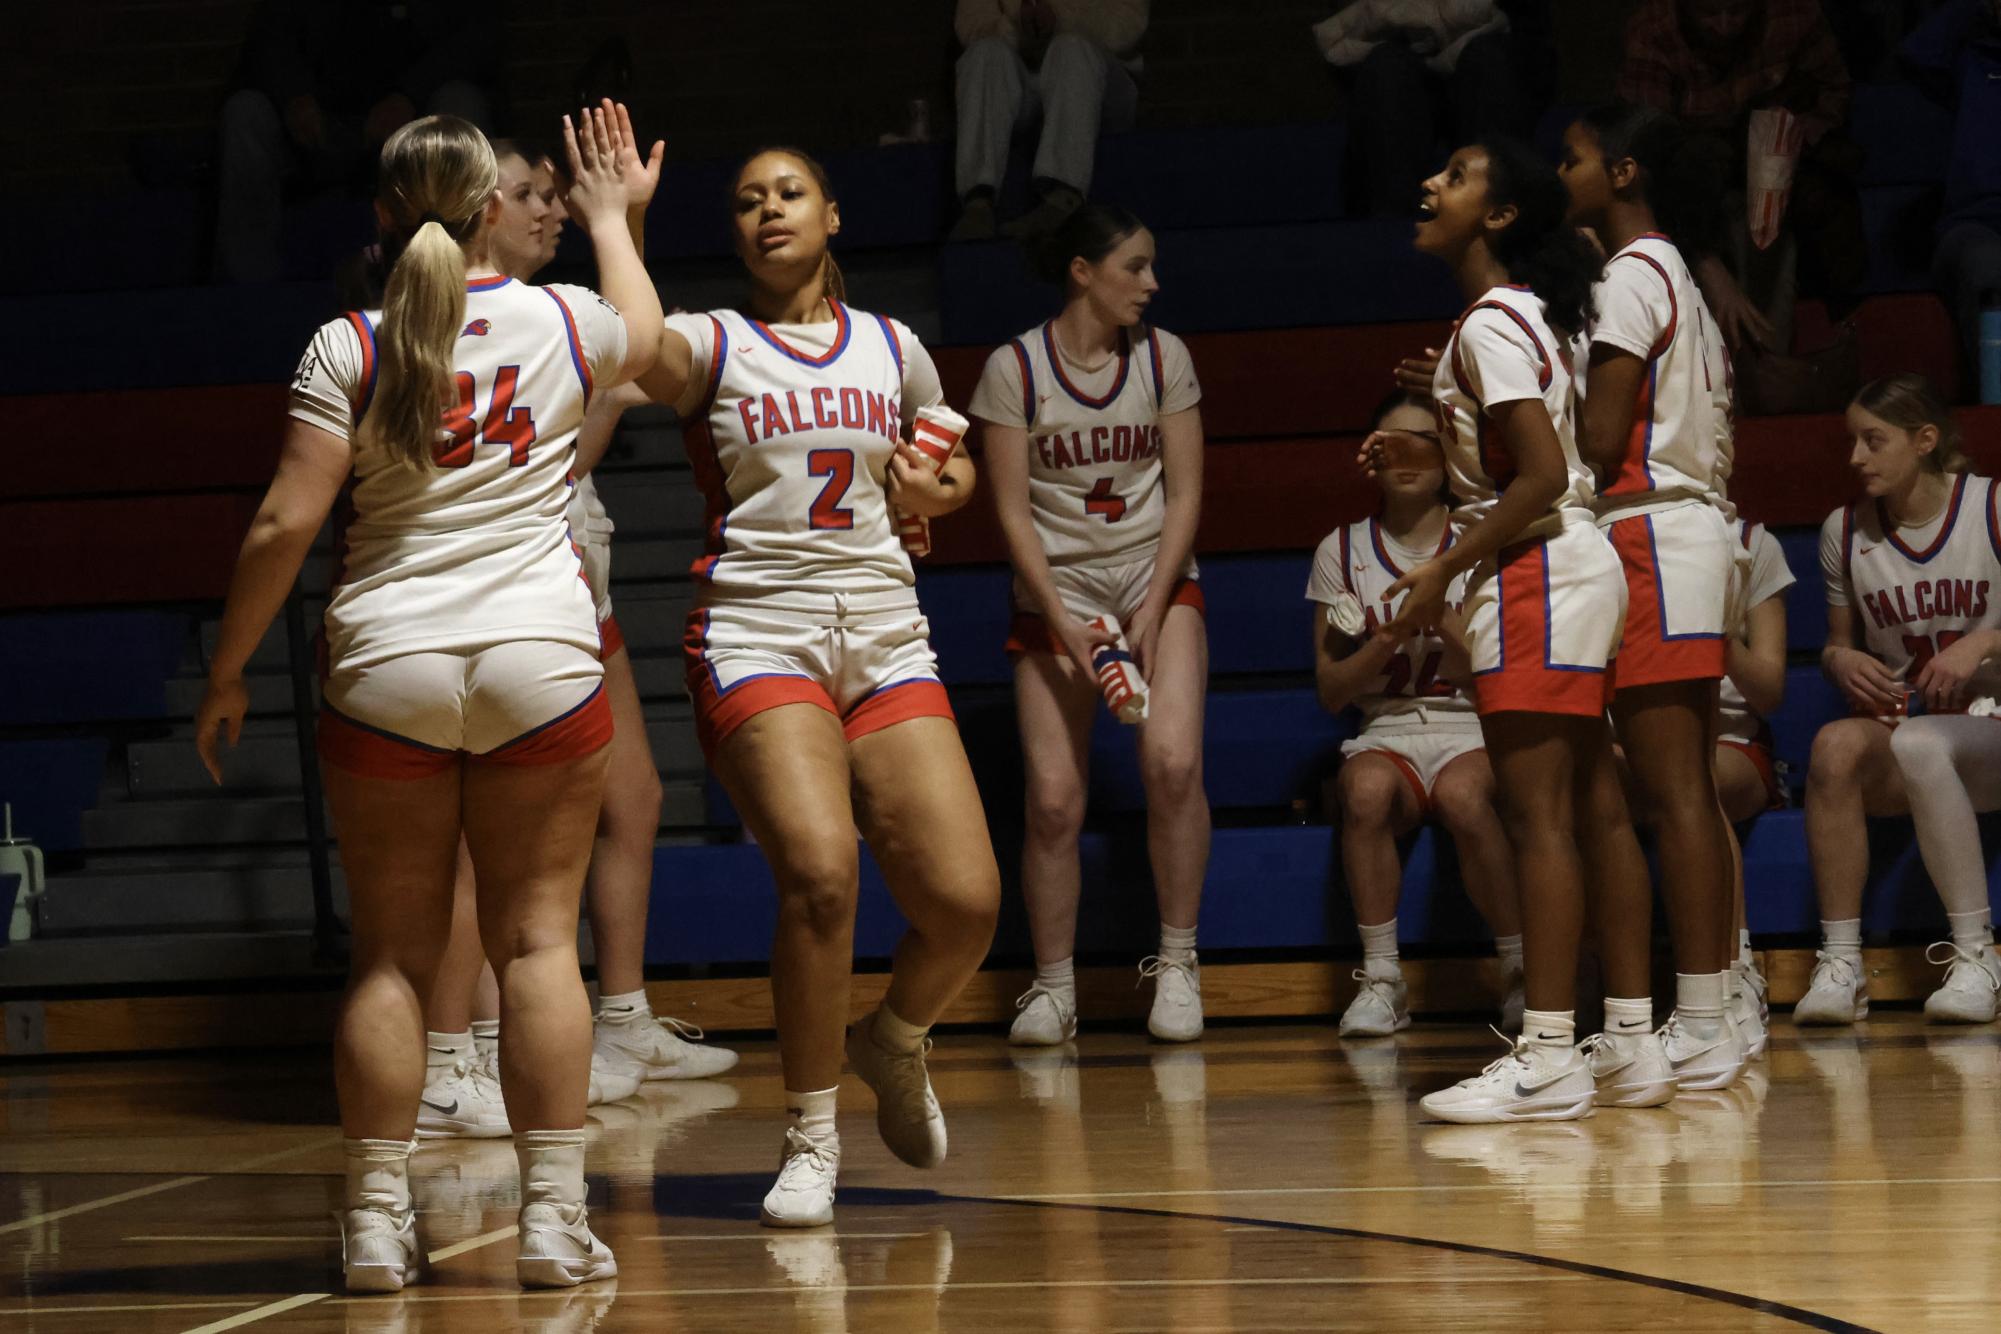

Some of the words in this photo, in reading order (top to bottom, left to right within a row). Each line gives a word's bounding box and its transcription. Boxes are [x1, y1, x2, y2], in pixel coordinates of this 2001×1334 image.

[430, 365, 536, 468] 34
[738, 387, 898, 444] FALCONS
[1036, 425, 1160, 470] FALCONS
[807, 448, 855, 530] 2
[1084, 477, 1126, 524] 4
[1863, 579, 1990, 629] FALCONS
[1902, 630, 1964, 684] 2
